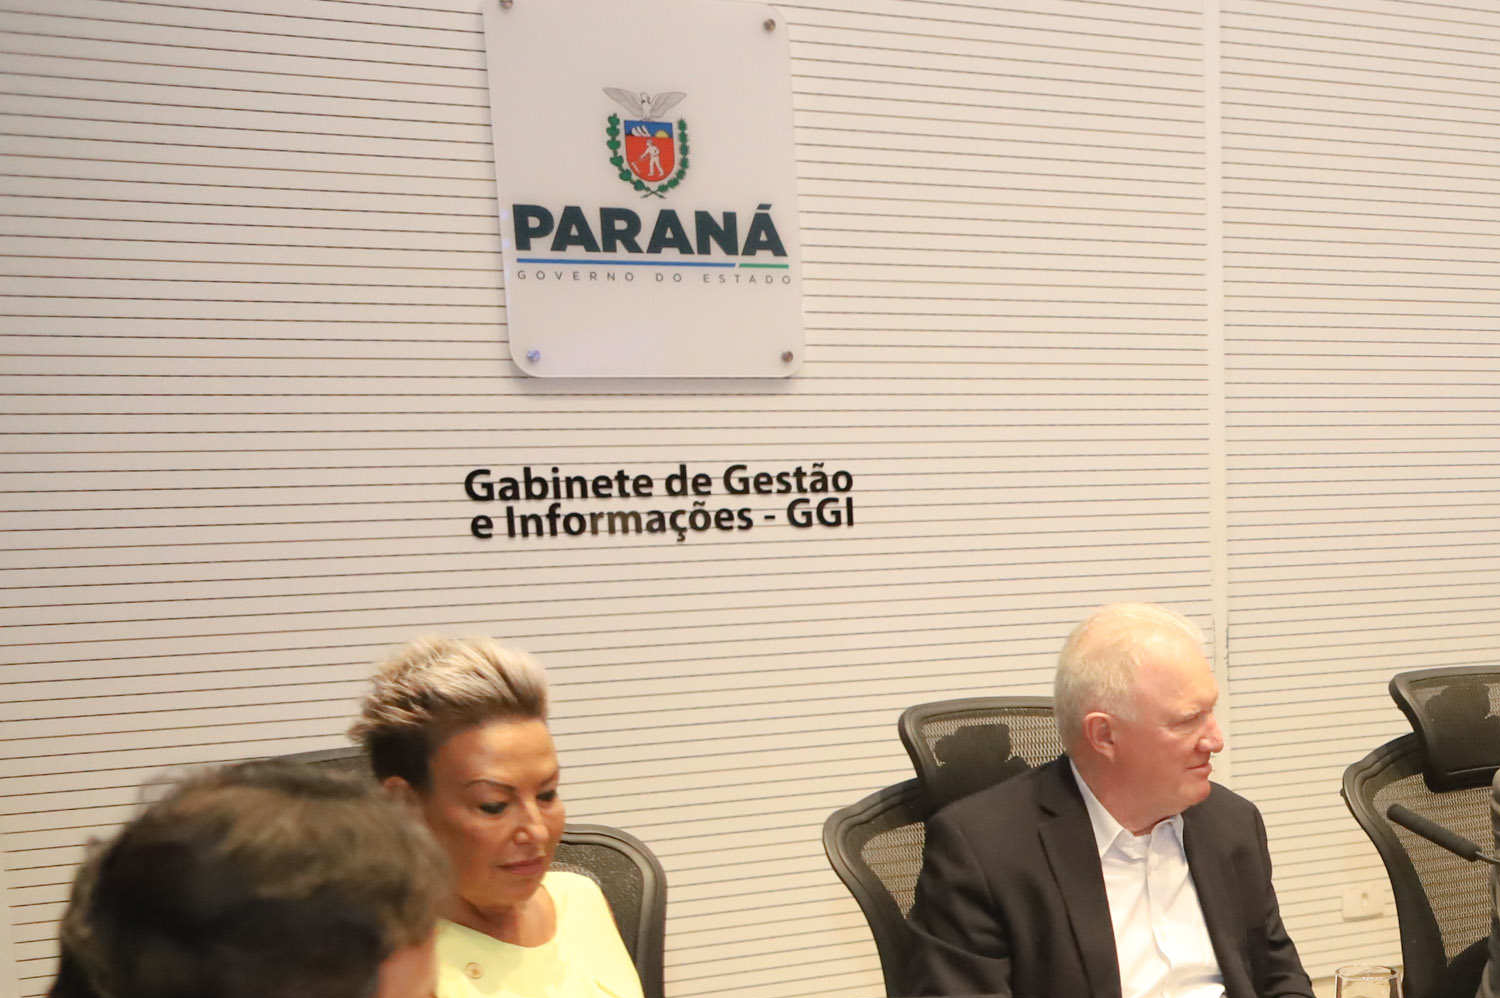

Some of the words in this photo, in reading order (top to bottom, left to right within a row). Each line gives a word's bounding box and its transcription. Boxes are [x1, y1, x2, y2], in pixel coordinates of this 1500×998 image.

[512, 203, 788, 257] PARANÁ
[517, 269, 635, 282] GOVERNO
[655, 272, 683, 283] DO
[703, 273, 792, 285] ESTADO
[464, 466, 655, 502] Gabinete
[665, 464, 713, 497] de
[723, 462, 854, 495] Gestão
[470, 513, 494, 539] e
[506, 501, 753, 542] Informações
[787, 497, 855, 529] GGI
